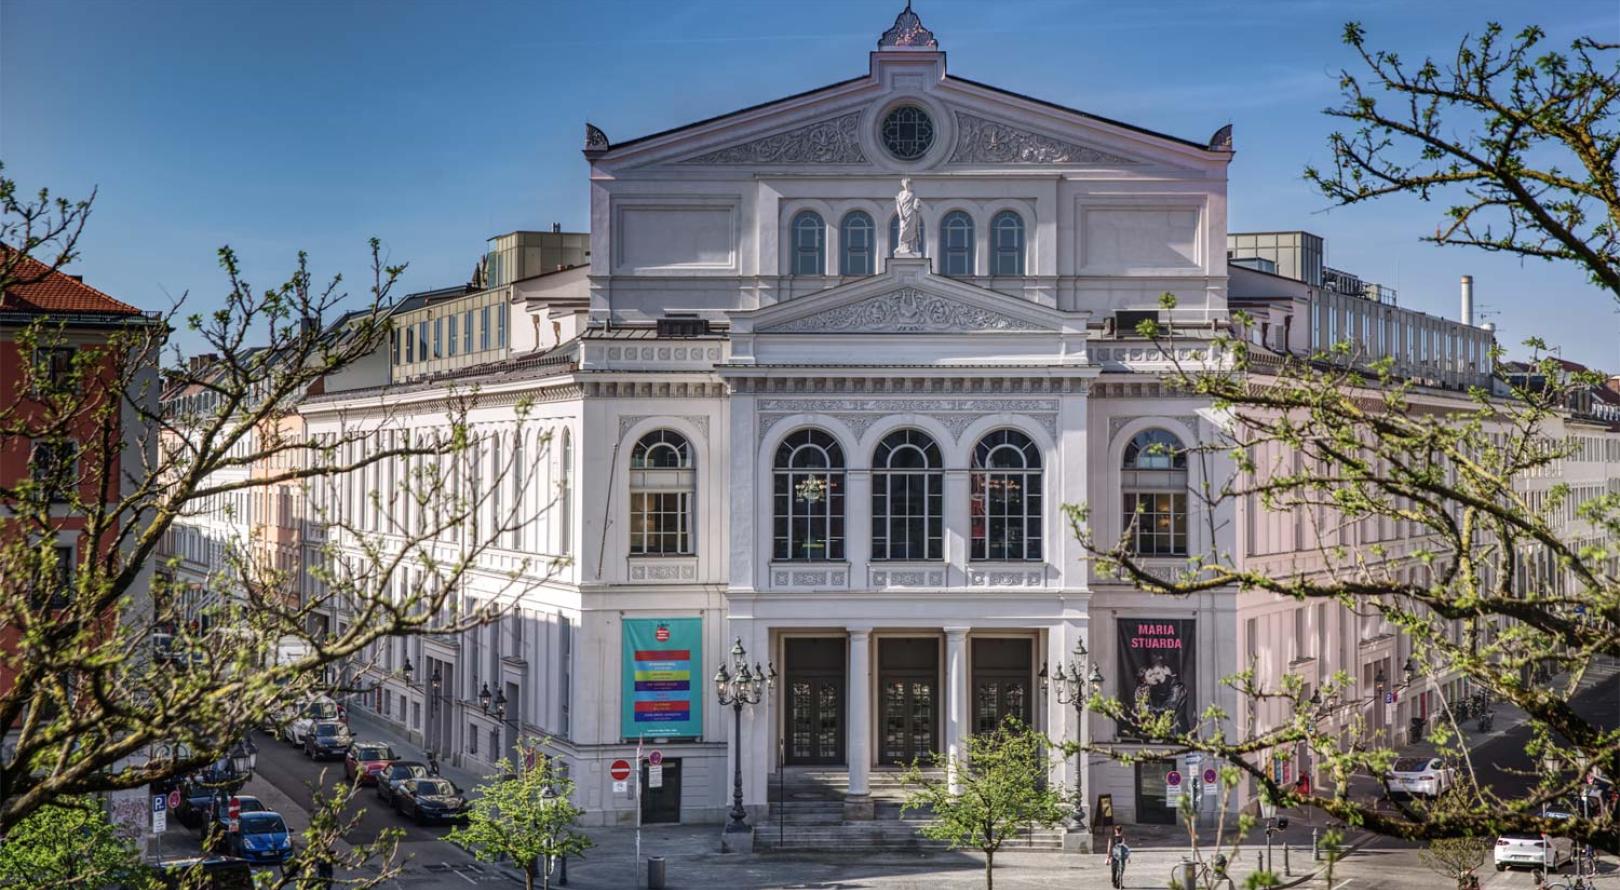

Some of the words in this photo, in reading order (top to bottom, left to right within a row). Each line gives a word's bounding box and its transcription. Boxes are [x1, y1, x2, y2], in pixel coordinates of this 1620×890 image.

[1138, 624, 1175, 635] MARIA
[1131, 637, 1182, 649] STUARDA
[155, 797, 163, 810] P
